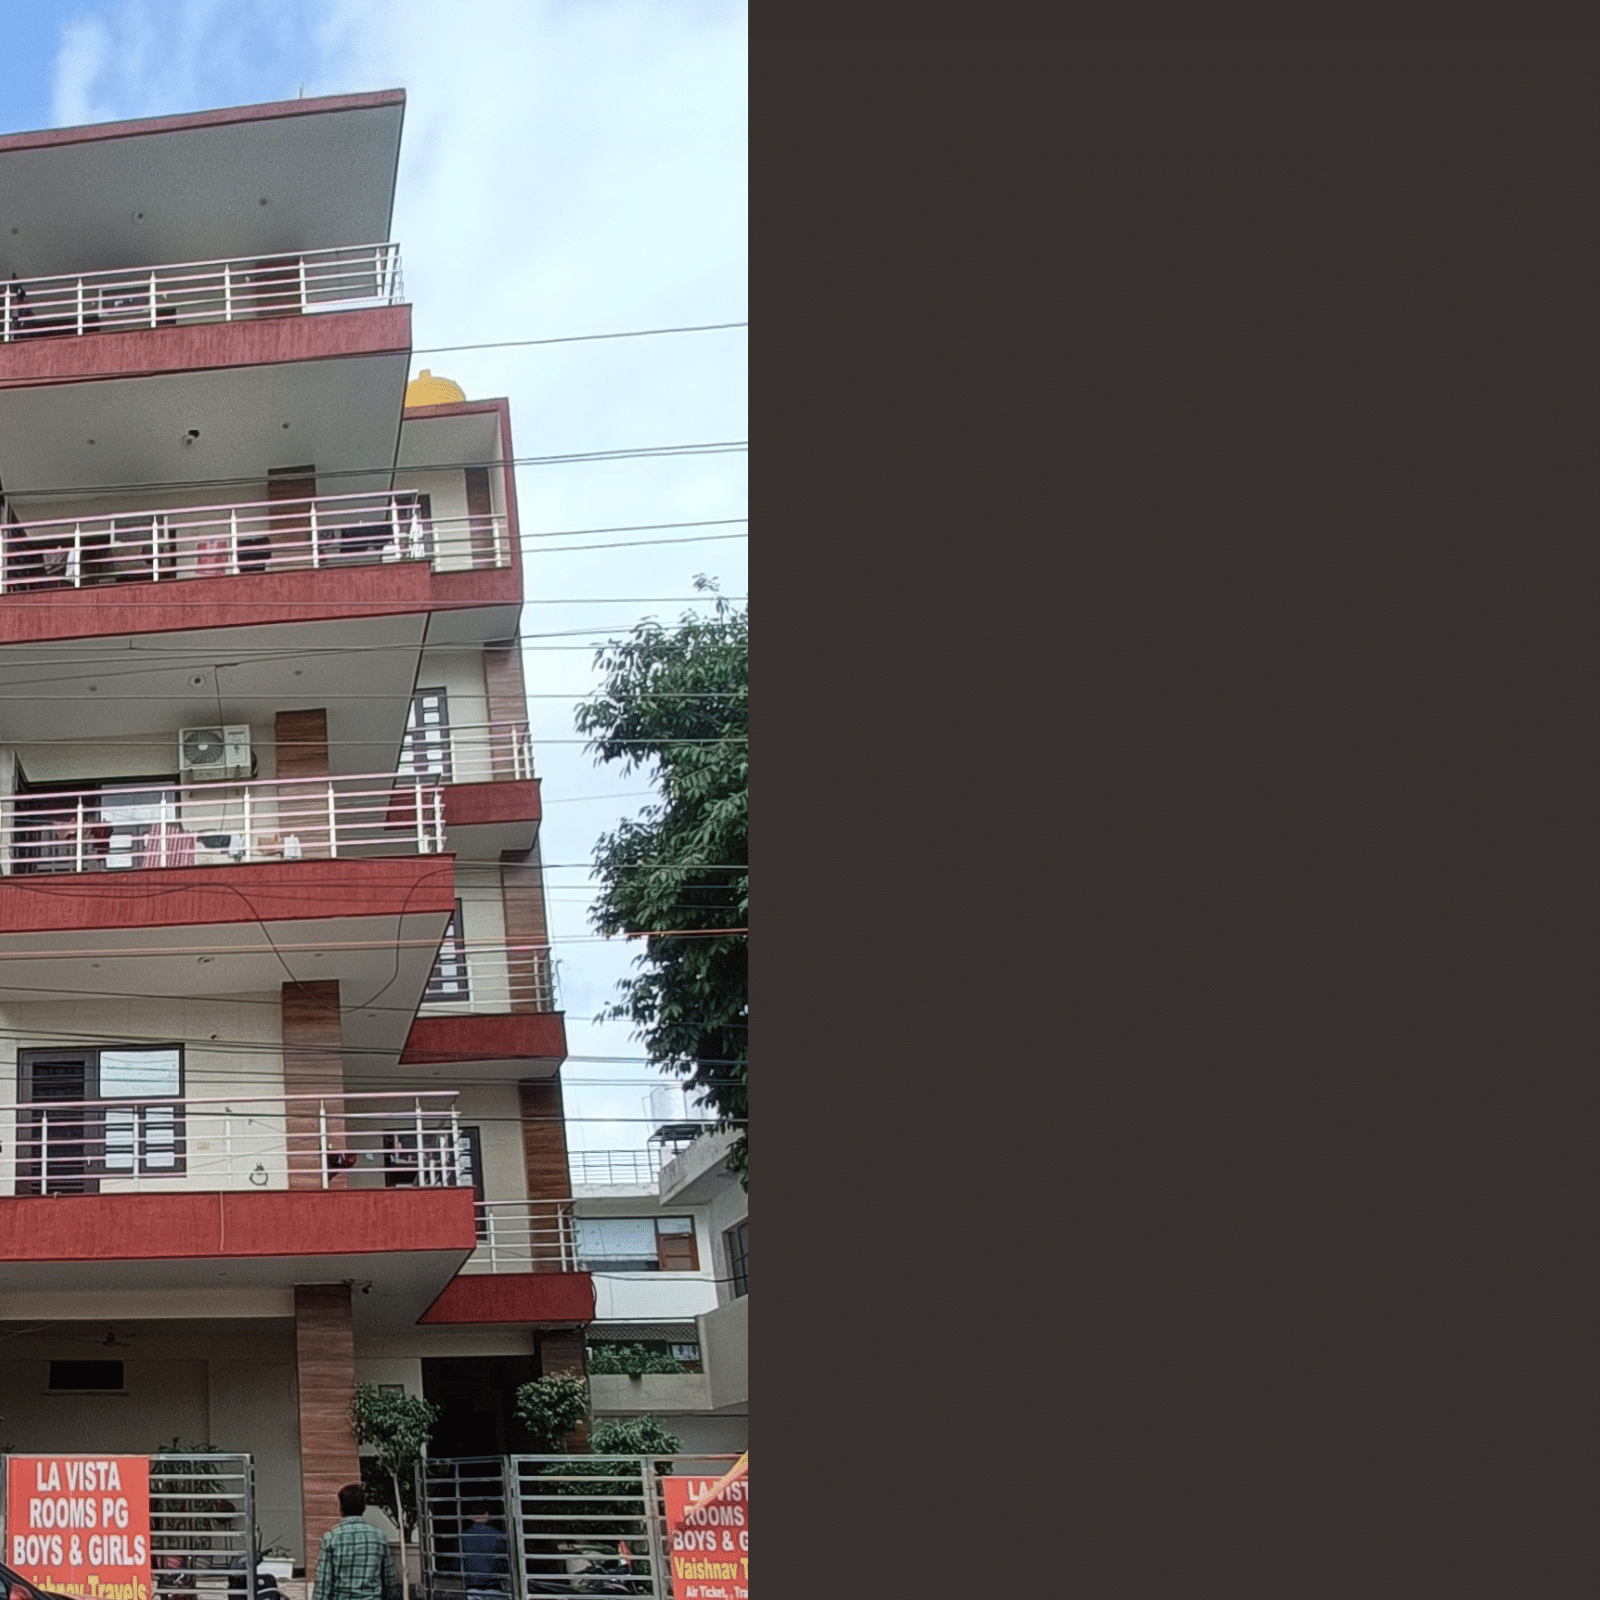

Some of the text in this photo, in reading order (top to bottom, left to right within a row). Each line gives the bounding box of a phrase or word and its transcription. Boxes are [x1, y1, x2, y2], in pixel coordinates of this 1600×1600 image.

[36, 1461, 122, 1491] LA VISTA
[30, 1497, 129, 1528] ROOMS PG
[684, 1505, 745, 1527] ROOMS
[13, 1535, 146, 1566] BOYS & GIRLS
[674, 1530, 717, 1551] BOYS
[721, 1530, 734, 1551] &
[674, 1557, 737, 1579] Vaishnav
